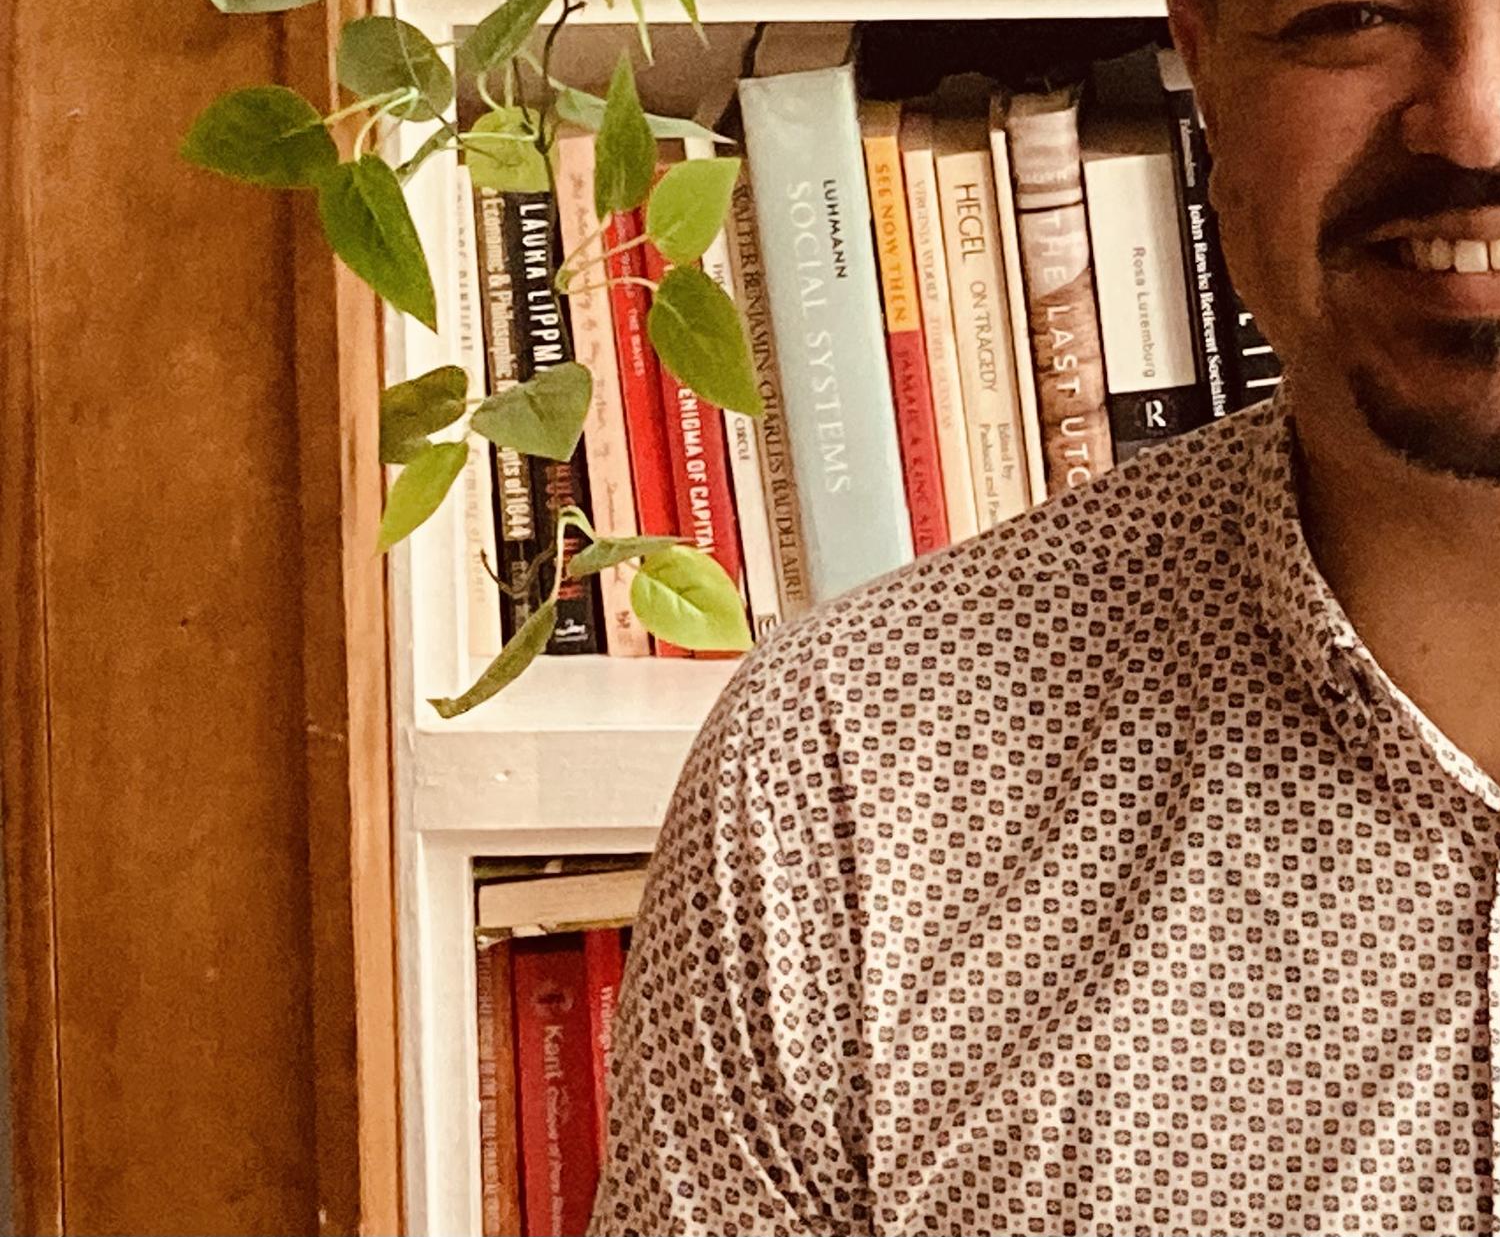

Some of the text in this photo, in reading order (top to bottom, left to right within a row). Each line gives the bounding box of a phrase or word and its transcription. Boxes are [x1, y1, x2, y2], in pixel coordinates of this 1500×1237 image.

[519, 202, 564, 372] LAURA LIPPM
[823, 178, 849, 280] LUHMANN
[882, 205, 900, 257] NOW
[889, 262, 908, 322] THEN
[954, 183, 998, 393] HEGEL ON TRAGEDY
[1037, 211, 1081, 395] THE LAST
[1187, 204, 1228, 417] John Reticent Socialist
[482, 197, 531, 537] Economic & Philosophic of 1844
[732, 183, 806, 602] WALTER BENJAMIN CHARLES BAUDELAIRE
[786, 180, 852, 495] SOCIAL SYSTEMS
[1131, 246, 1160, 378] Rosa Luxemburg
[677, 388, 715, 553] ENIGMA OF CAPITAL
[984, 475, 997, 498] and
[997, 422, 1016, 480] Edited by
[543, 1024, 563, 1080] Kant
